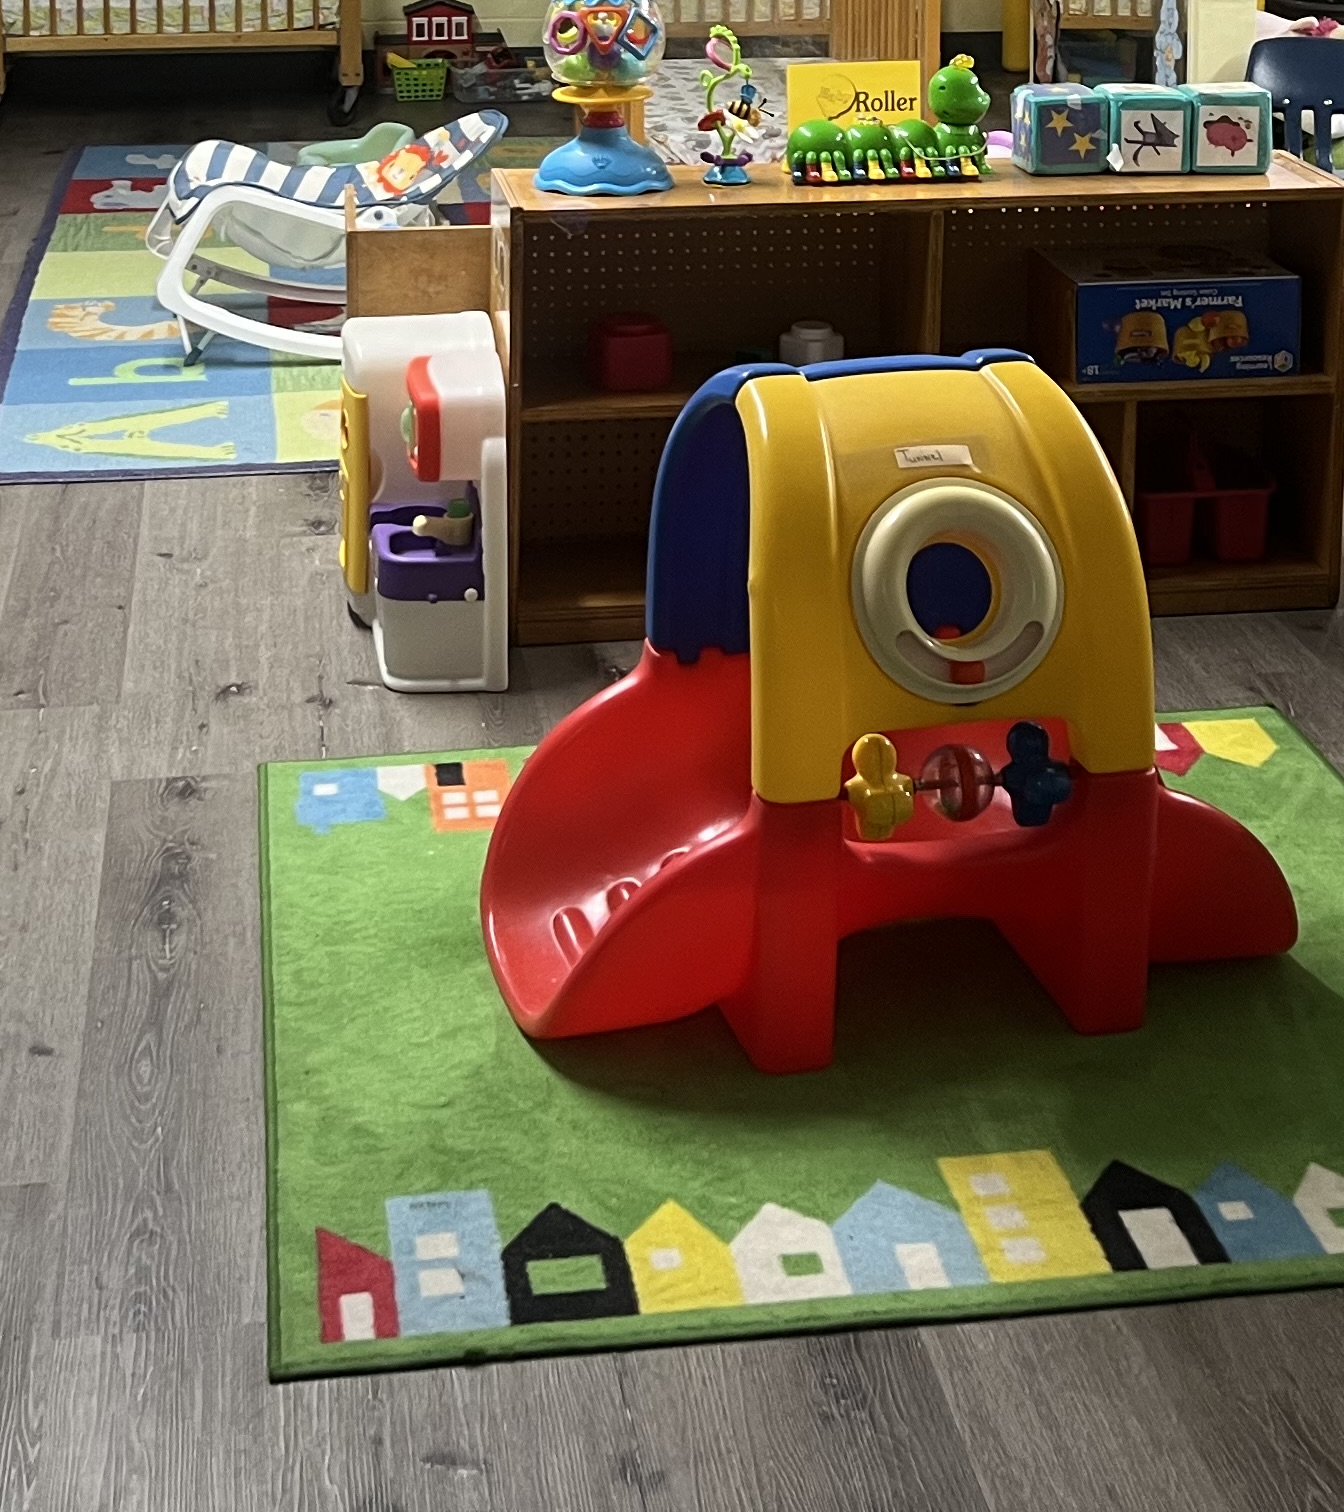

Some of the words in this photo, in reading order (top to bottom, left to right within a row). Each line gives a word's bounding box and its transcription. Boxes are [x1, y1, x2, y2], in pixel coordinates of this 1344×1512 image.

[854, 90, 918, 113] Roller
[1134, 297, 1182, 310] Market
[1185, 296, 1243, 309] Farmer's
